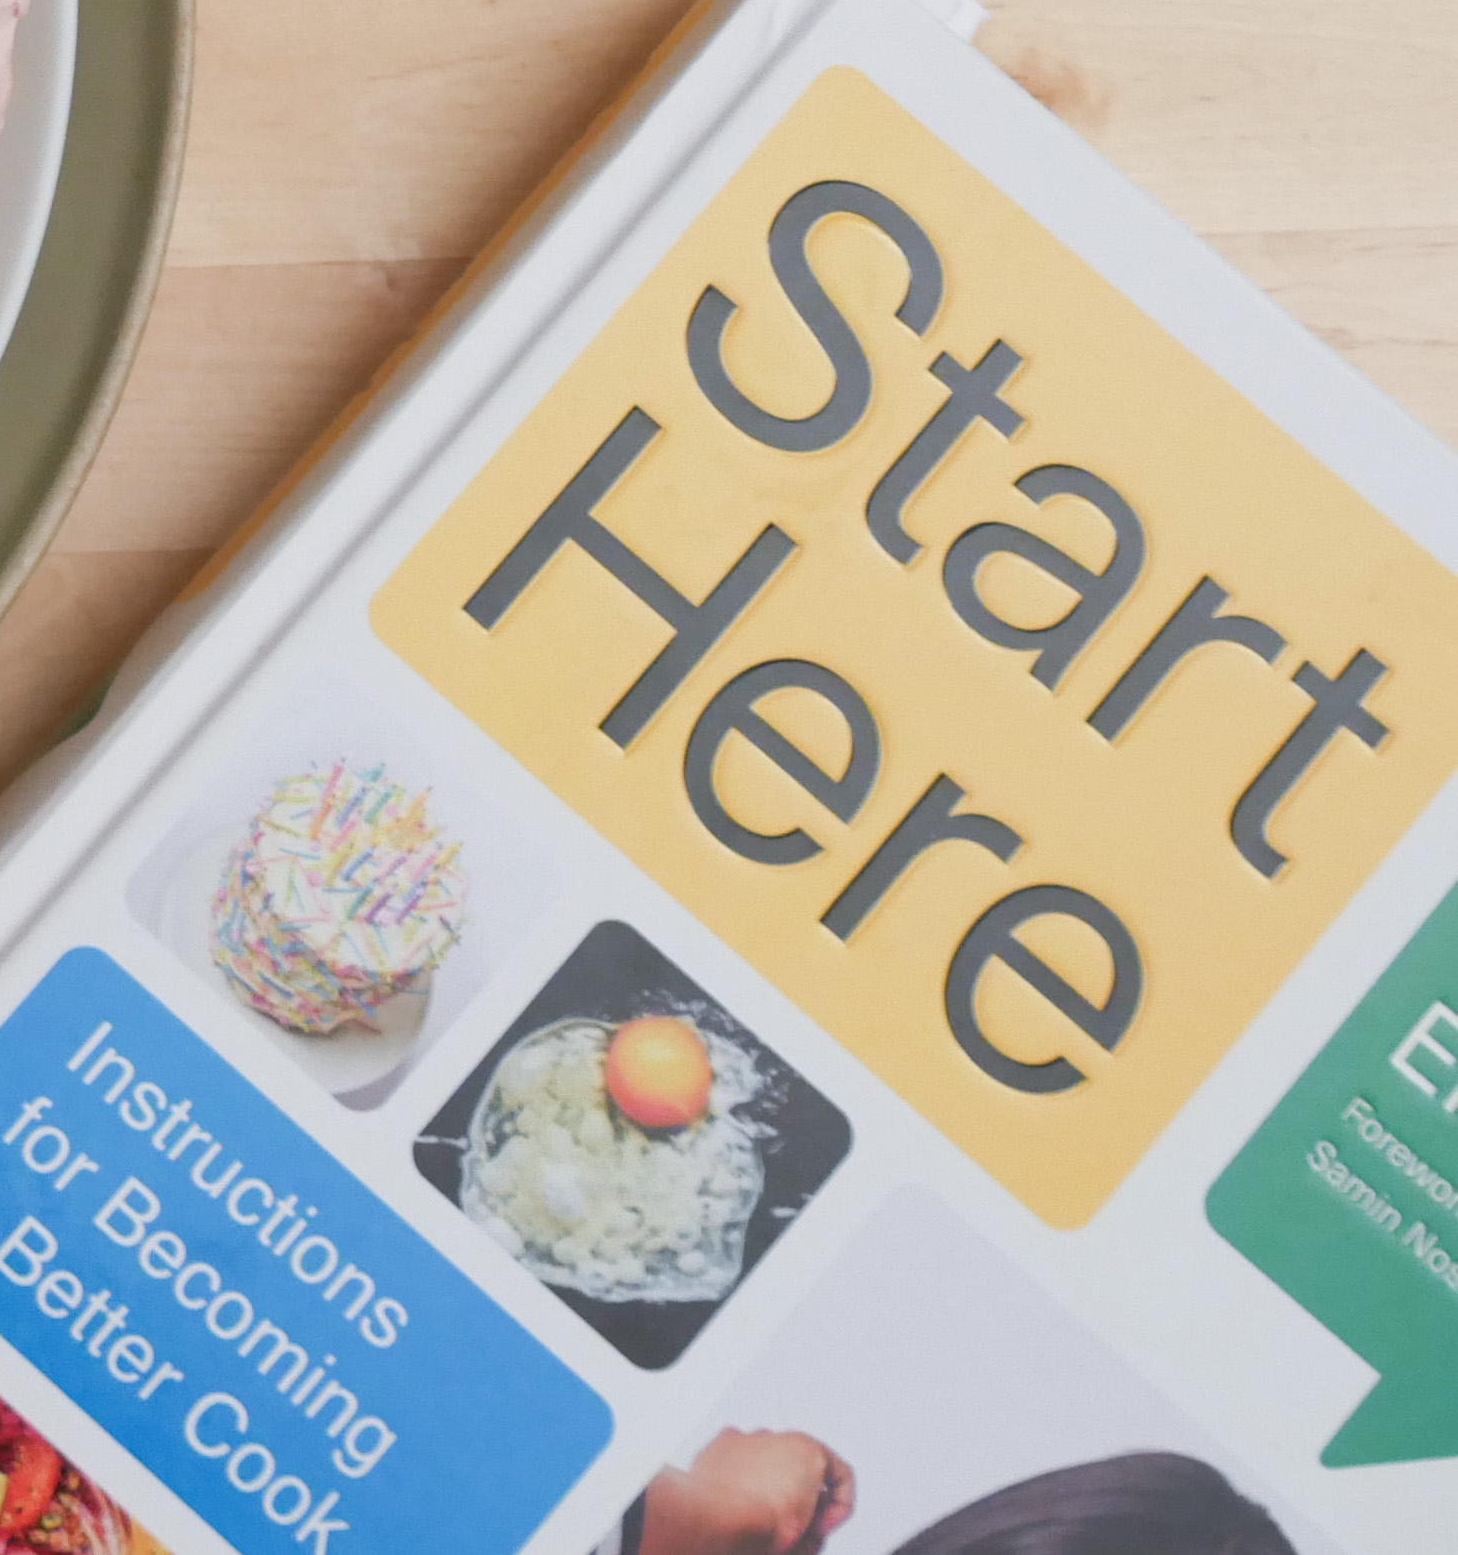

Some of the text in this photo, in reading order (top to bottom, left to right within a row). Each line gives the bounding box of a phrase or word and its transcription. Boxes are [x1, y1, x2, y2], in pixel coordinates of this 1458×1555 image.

[686, 179, 1390, 879] Start
[462, 405, 1144, 1095] Here
[1341, 1097, 1458, 1221] Forewor
[1388, 1000, 1458, 1114] E
[2, 1096, 397, 1479] for Becoming
[66, 1020, 409, 1348] Instructions
[1306, 1140, 1402, 1233] Samin
[184, 1392, 350, 1555] Cook
